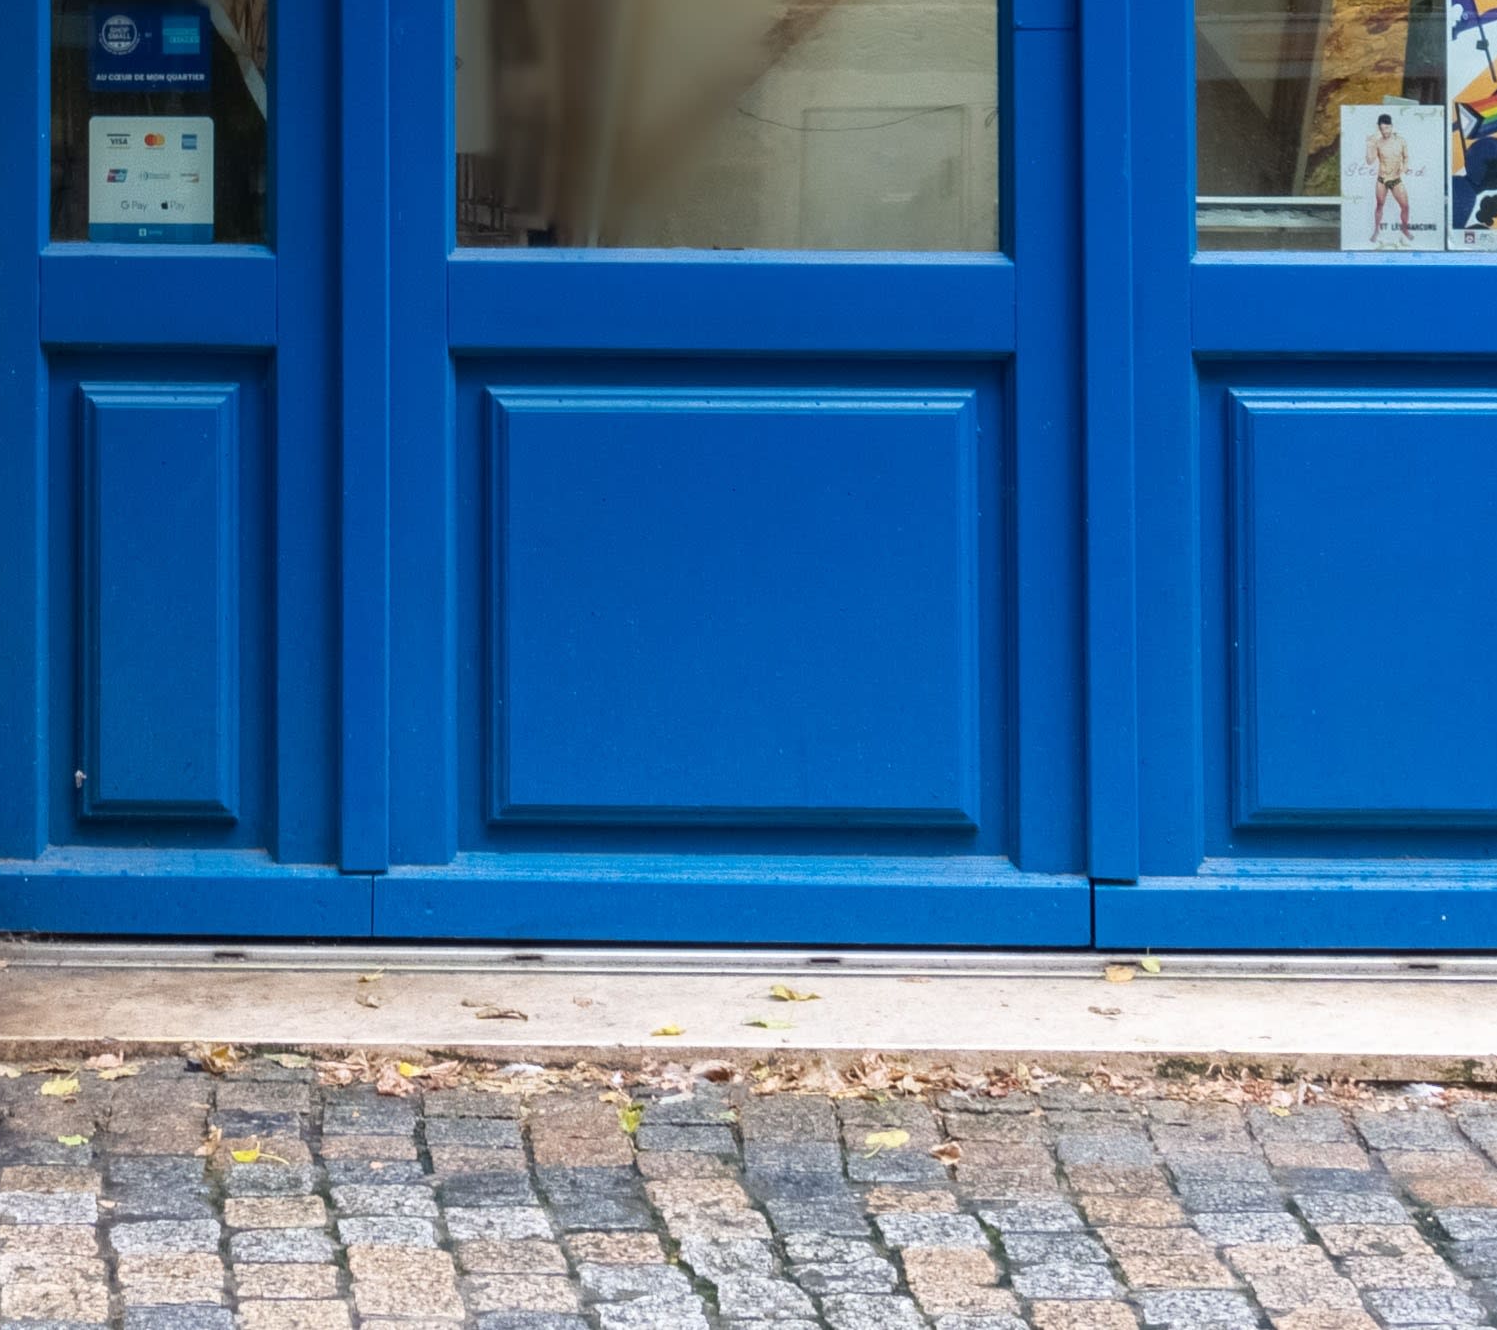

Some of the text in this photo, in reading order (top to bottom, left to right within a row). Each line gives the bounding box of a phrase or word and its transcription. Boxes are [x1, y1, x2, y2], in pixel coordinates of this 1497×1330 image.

[96, 73, 107, 82] AU
[134, 73, 145, 82] DE
[146, 73, 165, 82] MON
[166, 73, 205, 83] QUARTIER
[110, 137, 128, 146] VISA
[131, 200, 148, 212] Pay
